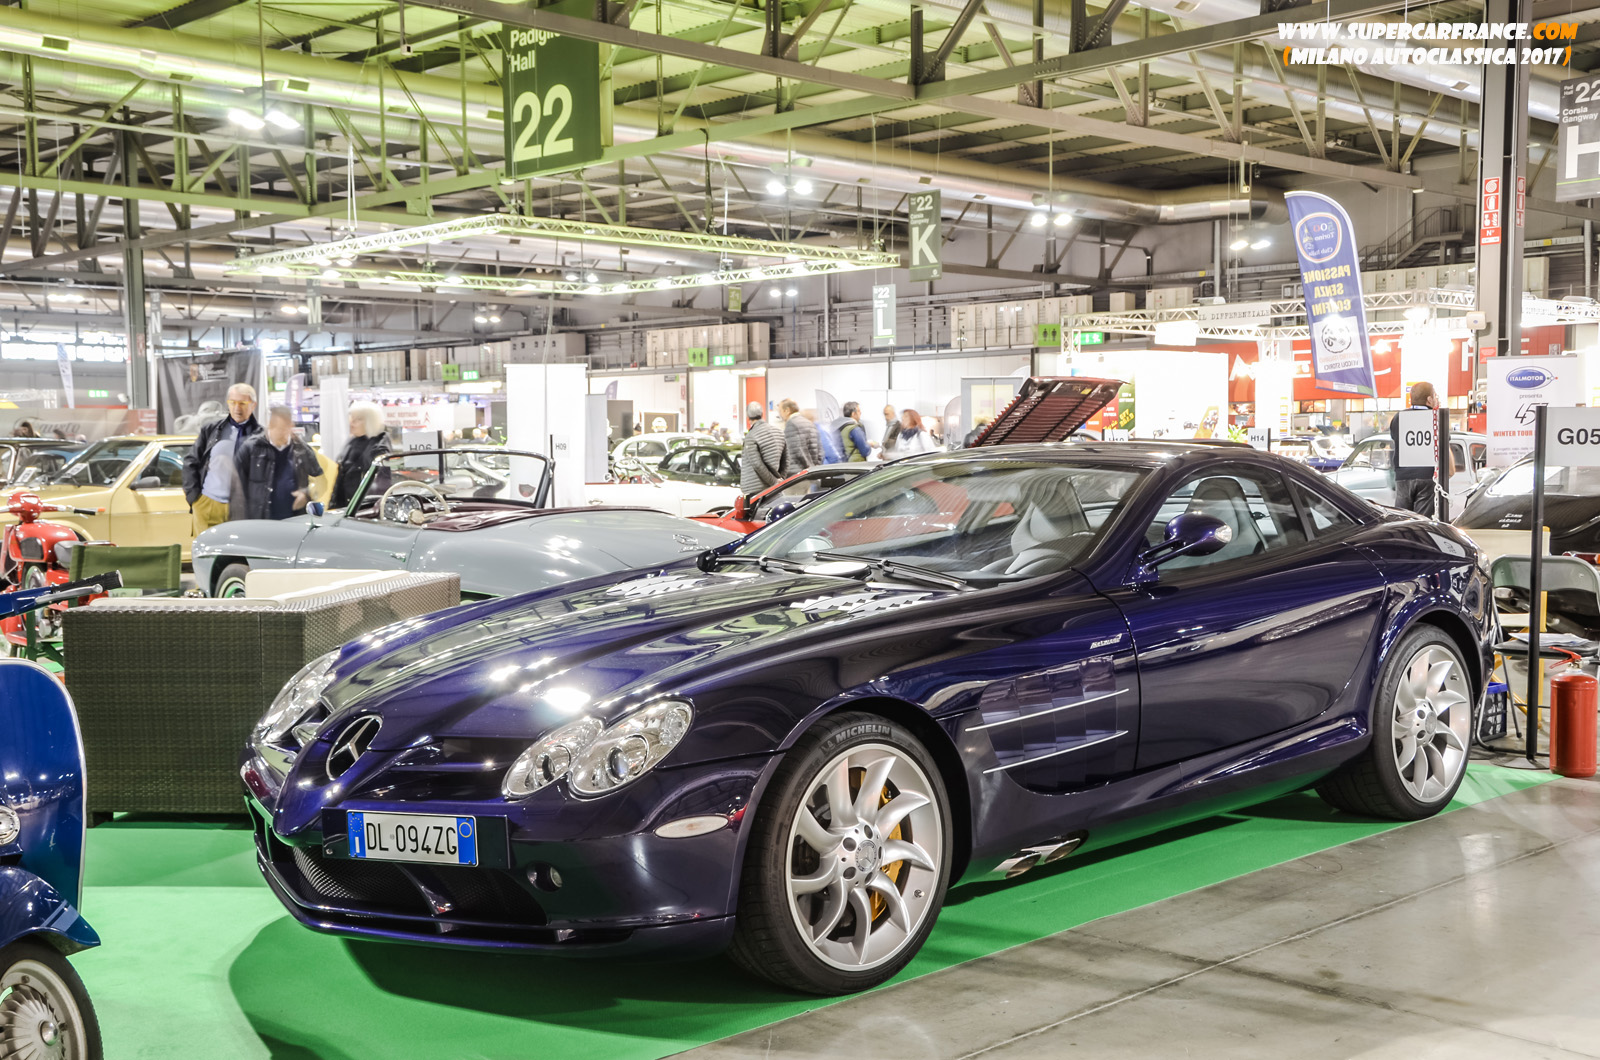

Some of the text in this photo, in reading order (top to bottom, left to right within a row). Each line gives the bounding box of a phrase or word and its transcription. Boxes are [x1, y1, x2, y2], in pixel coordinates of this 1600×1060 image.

[511, 50, 536, 73] Hall
[1575, 79, 1600, 104] 22
[1562, 105, 1588, 116] Corsia
[1562, 112, 1599, 124] Gangway
[513, 83, 574, 163] 22
[1565, 125, 1600, 179] H
[916, 194, 934, 212] 22
[911, 223, 939, 266] K
[307, 296, 322, 325] M
[1211, 309, 1270, 320] DIFFERENZIALE
[151, 311, 161, 334] N
[876, 308, 893, 336] L
[1250, 434, 1265, 442] H14
[1405, 430, 1432, 447] G09
[1493, 429, 1533, 438] WINTER TOUR
[1557, 427, 1600, 445] G05
[835, 724, 891, 743] MICHELIN
[366, 822, 389, 851] DL
[395, 824, 457, 855] 094ZG
